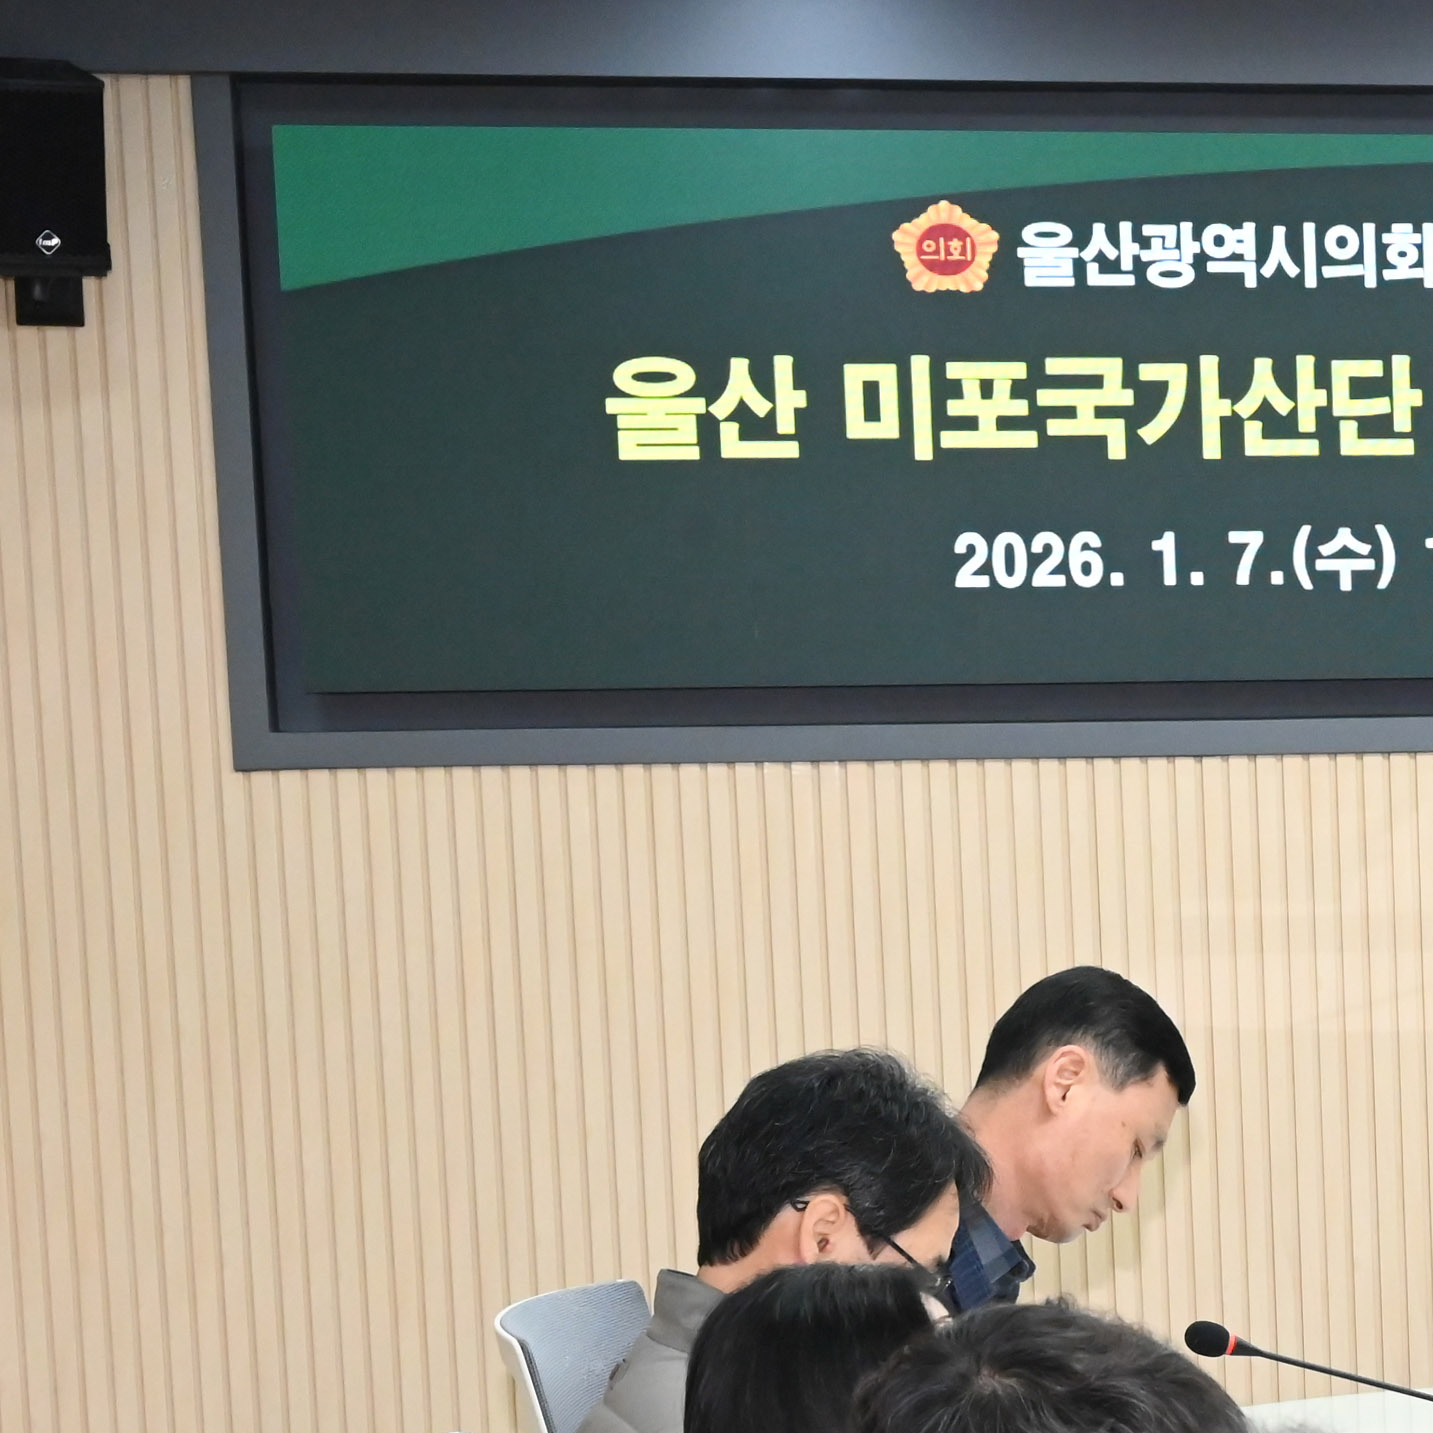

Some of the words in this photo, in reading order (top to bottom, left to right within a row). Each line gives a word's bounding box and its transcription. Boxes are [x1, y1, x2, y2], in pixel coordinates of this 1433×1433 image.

[920, 236, 972, 262] 의회
[604, 354, 808, 462] 울산
[842, 354, 1424, 461] 미포국가산단
[953, 530, 1125, 589] 2026.
[1150, 530, 1206, 587] 1.
[1227, 523, 1396, 592] 7.(수)
